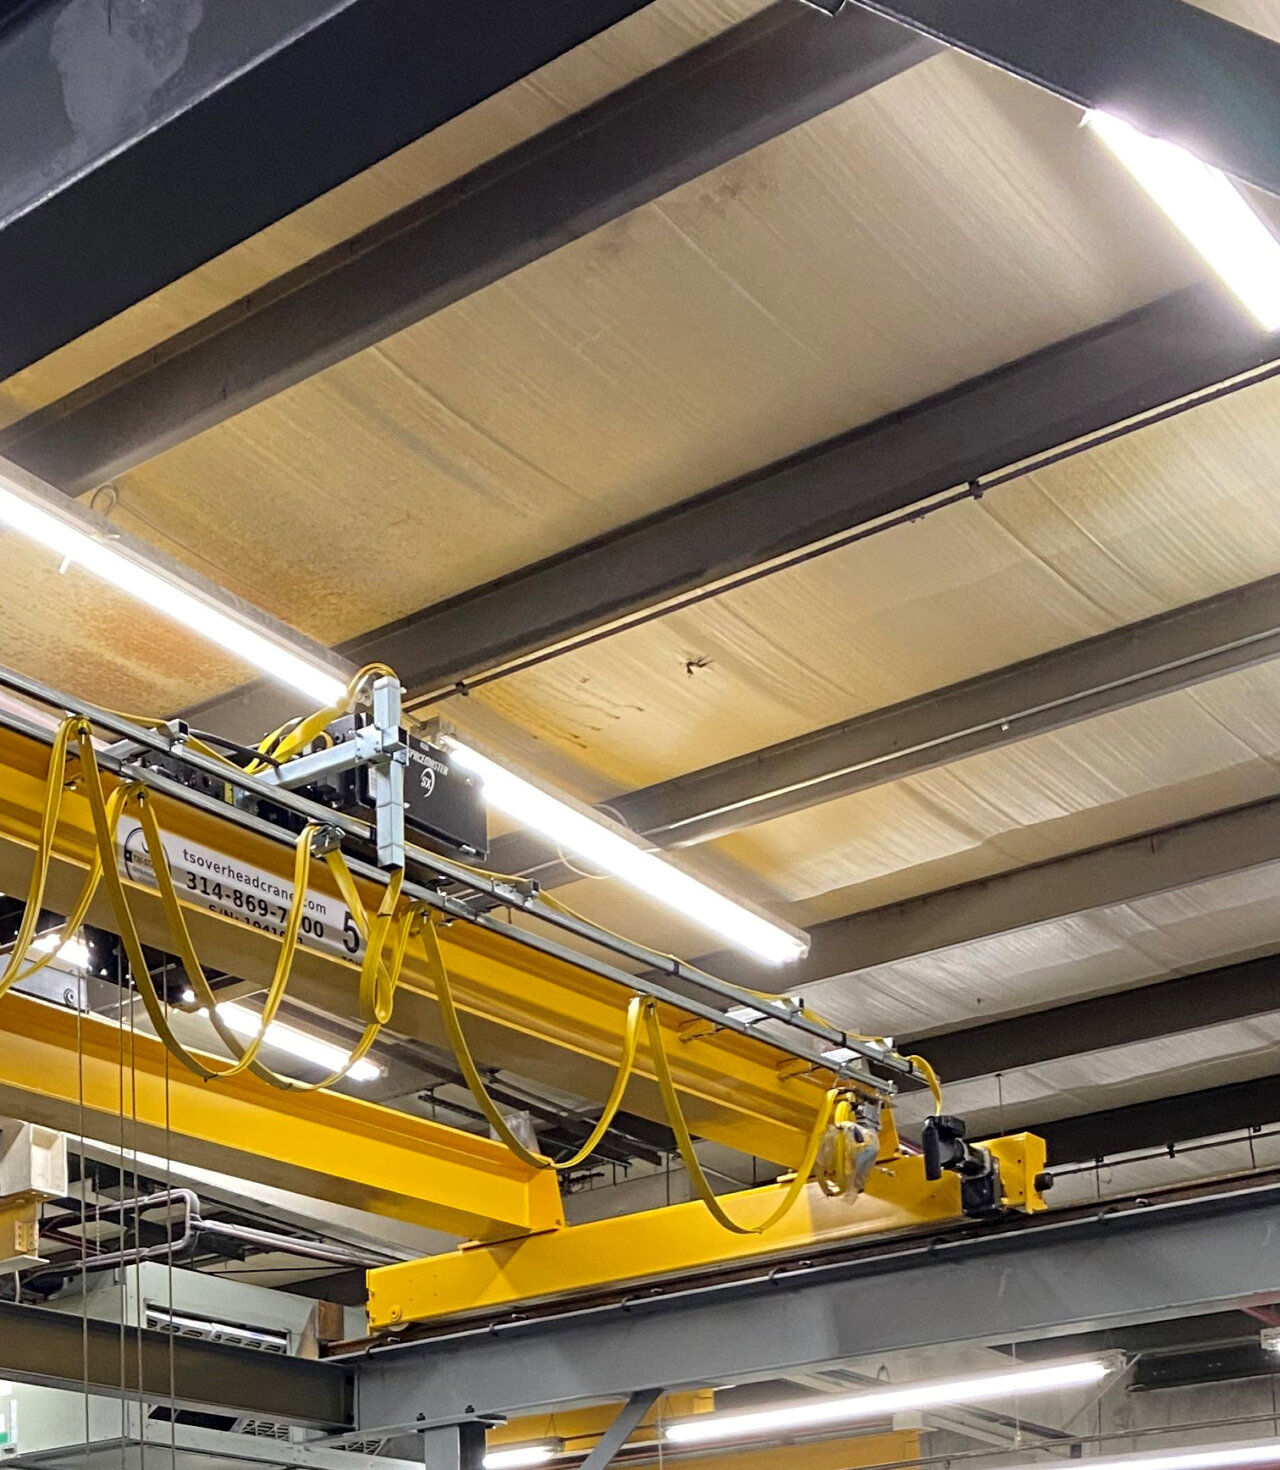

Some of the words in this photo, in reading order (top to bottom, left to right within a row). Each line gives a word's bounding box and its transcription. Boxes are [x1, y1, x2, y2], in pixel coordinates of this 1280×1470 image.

[183, 849, 326, 914] tsoverheadcraneom
[186, 871, 324, 938] 314-869-700
[343, 910, 360, 953] 5
